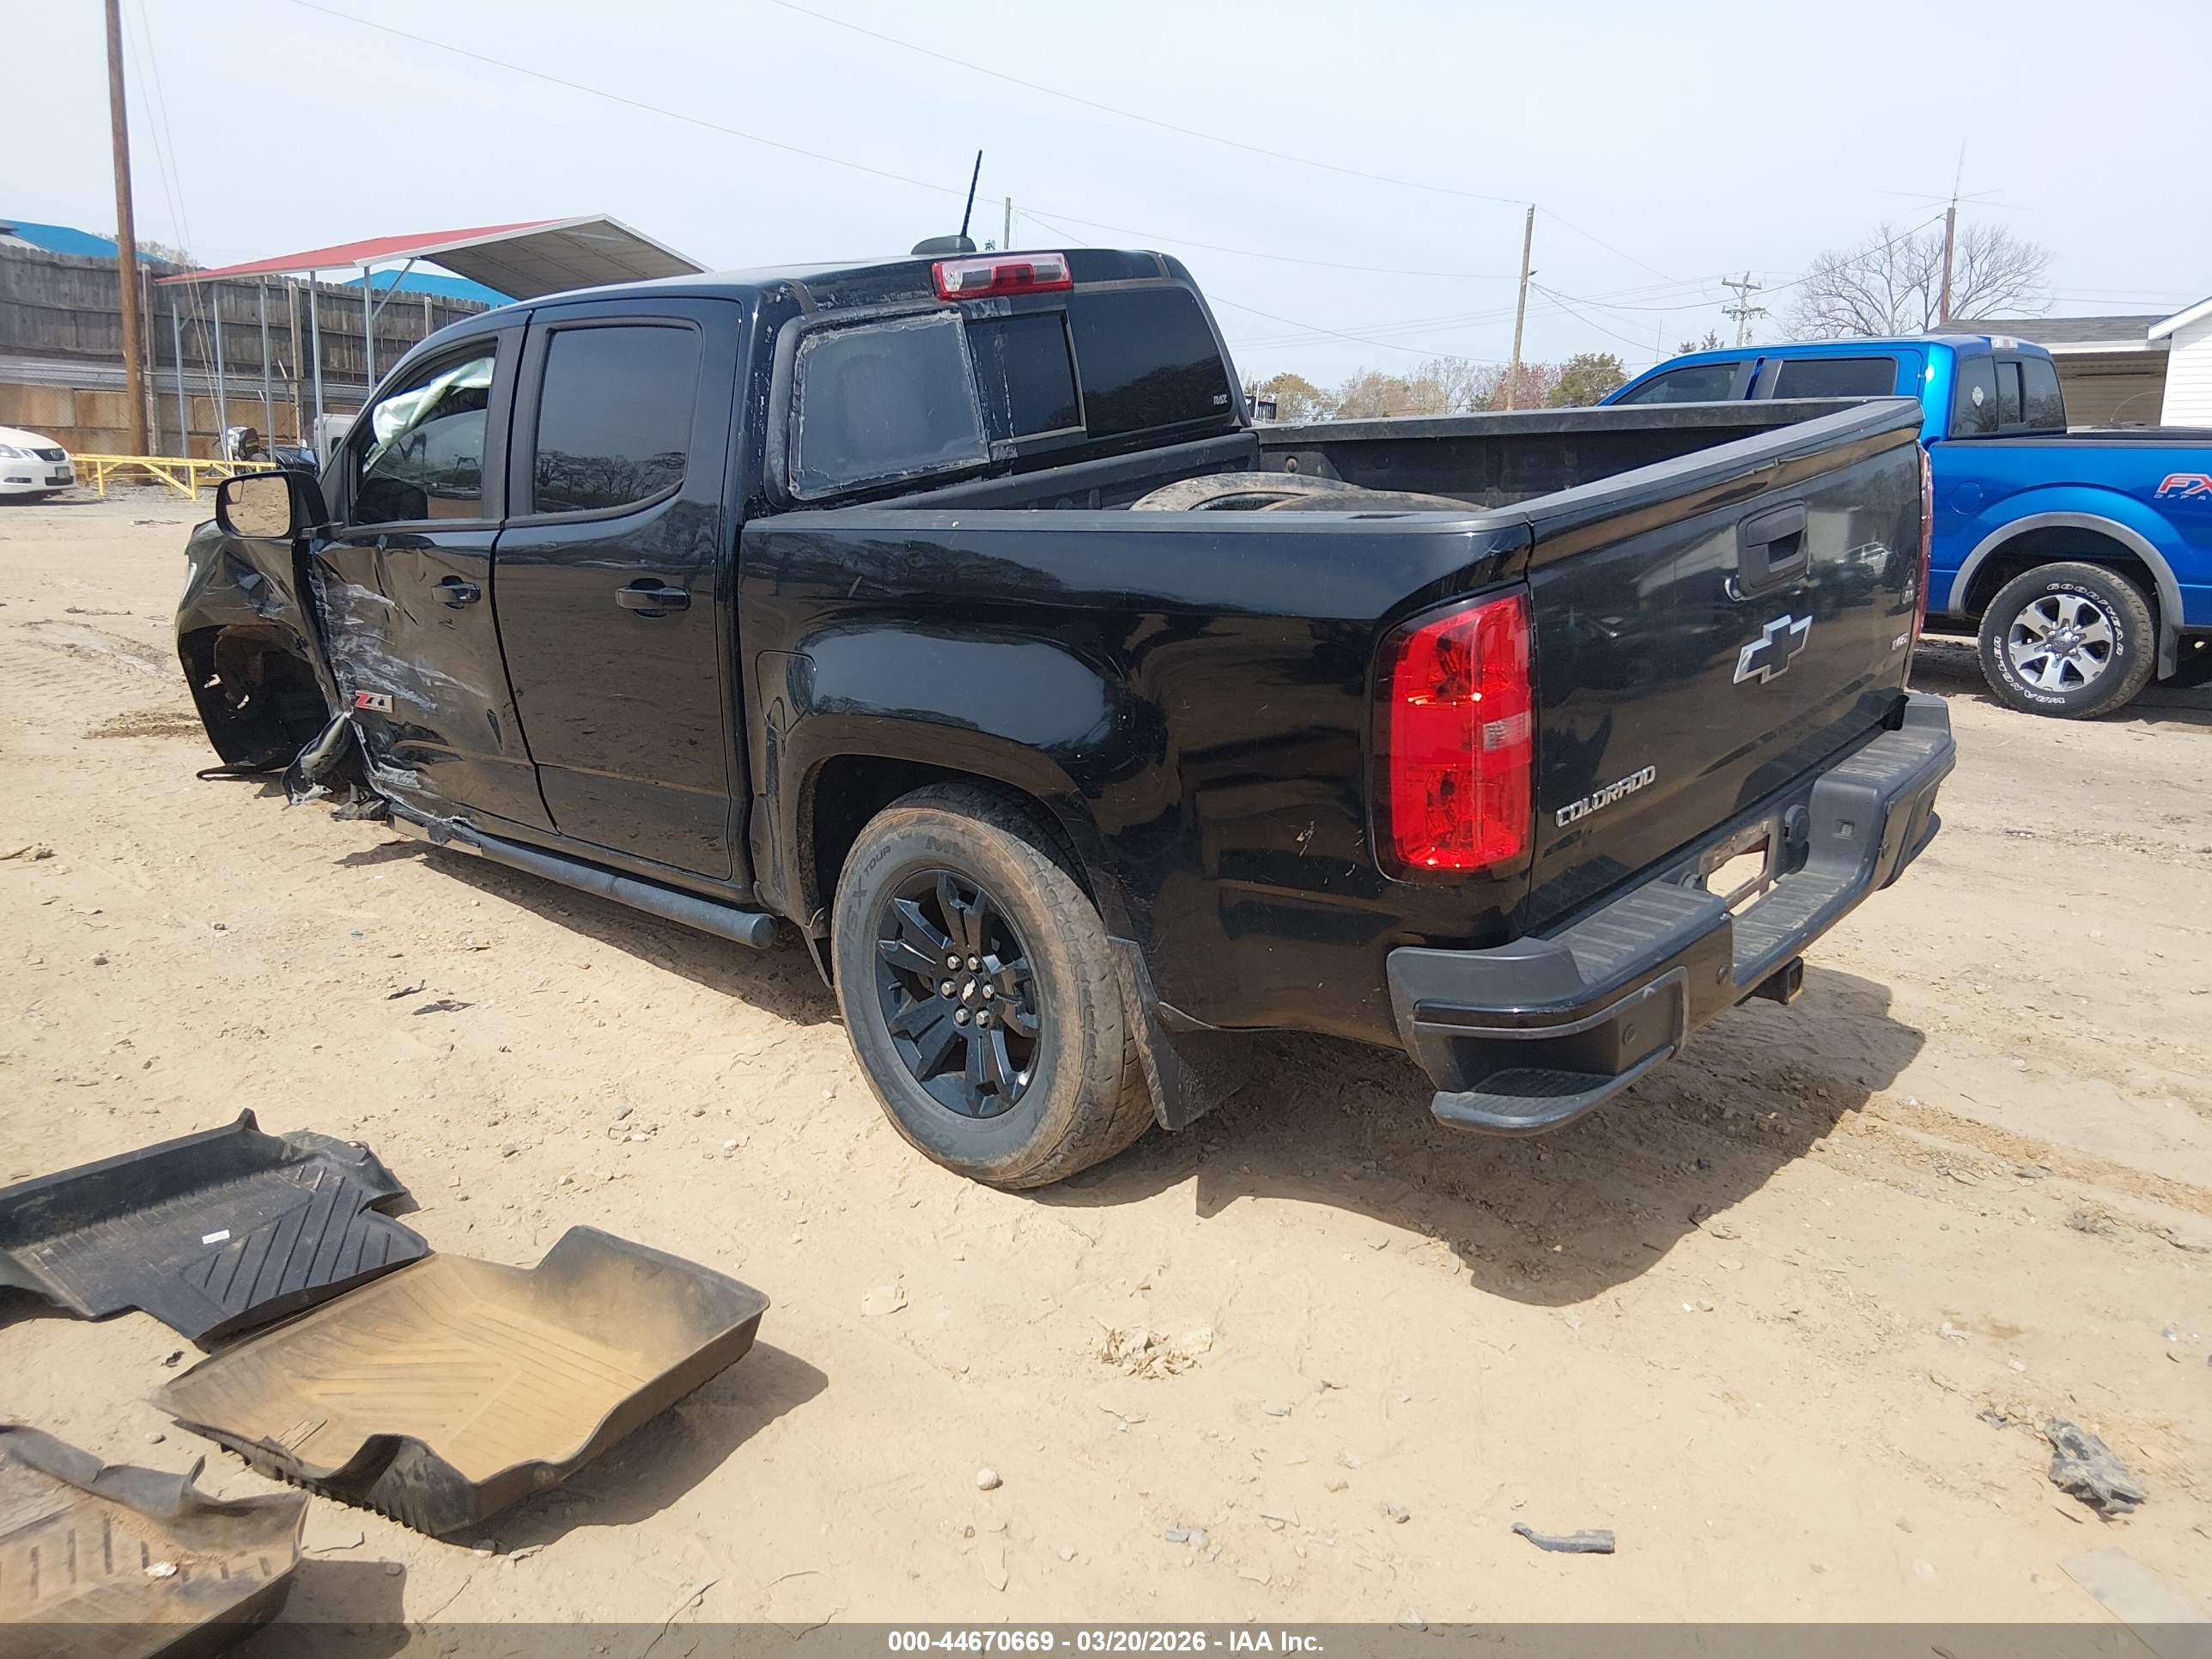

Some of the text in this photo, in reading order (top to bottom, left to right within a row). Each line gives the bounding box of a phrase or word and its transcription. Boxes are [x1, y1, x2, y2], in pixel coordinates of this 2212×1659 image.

[2046, 583, 2124, 656] GOODYEAR
[1993, 635, 2065, 703] WRANGLER
[1555, 764, 1656, 828] COLORADO
[863, 844, 891, 876] TOUR
